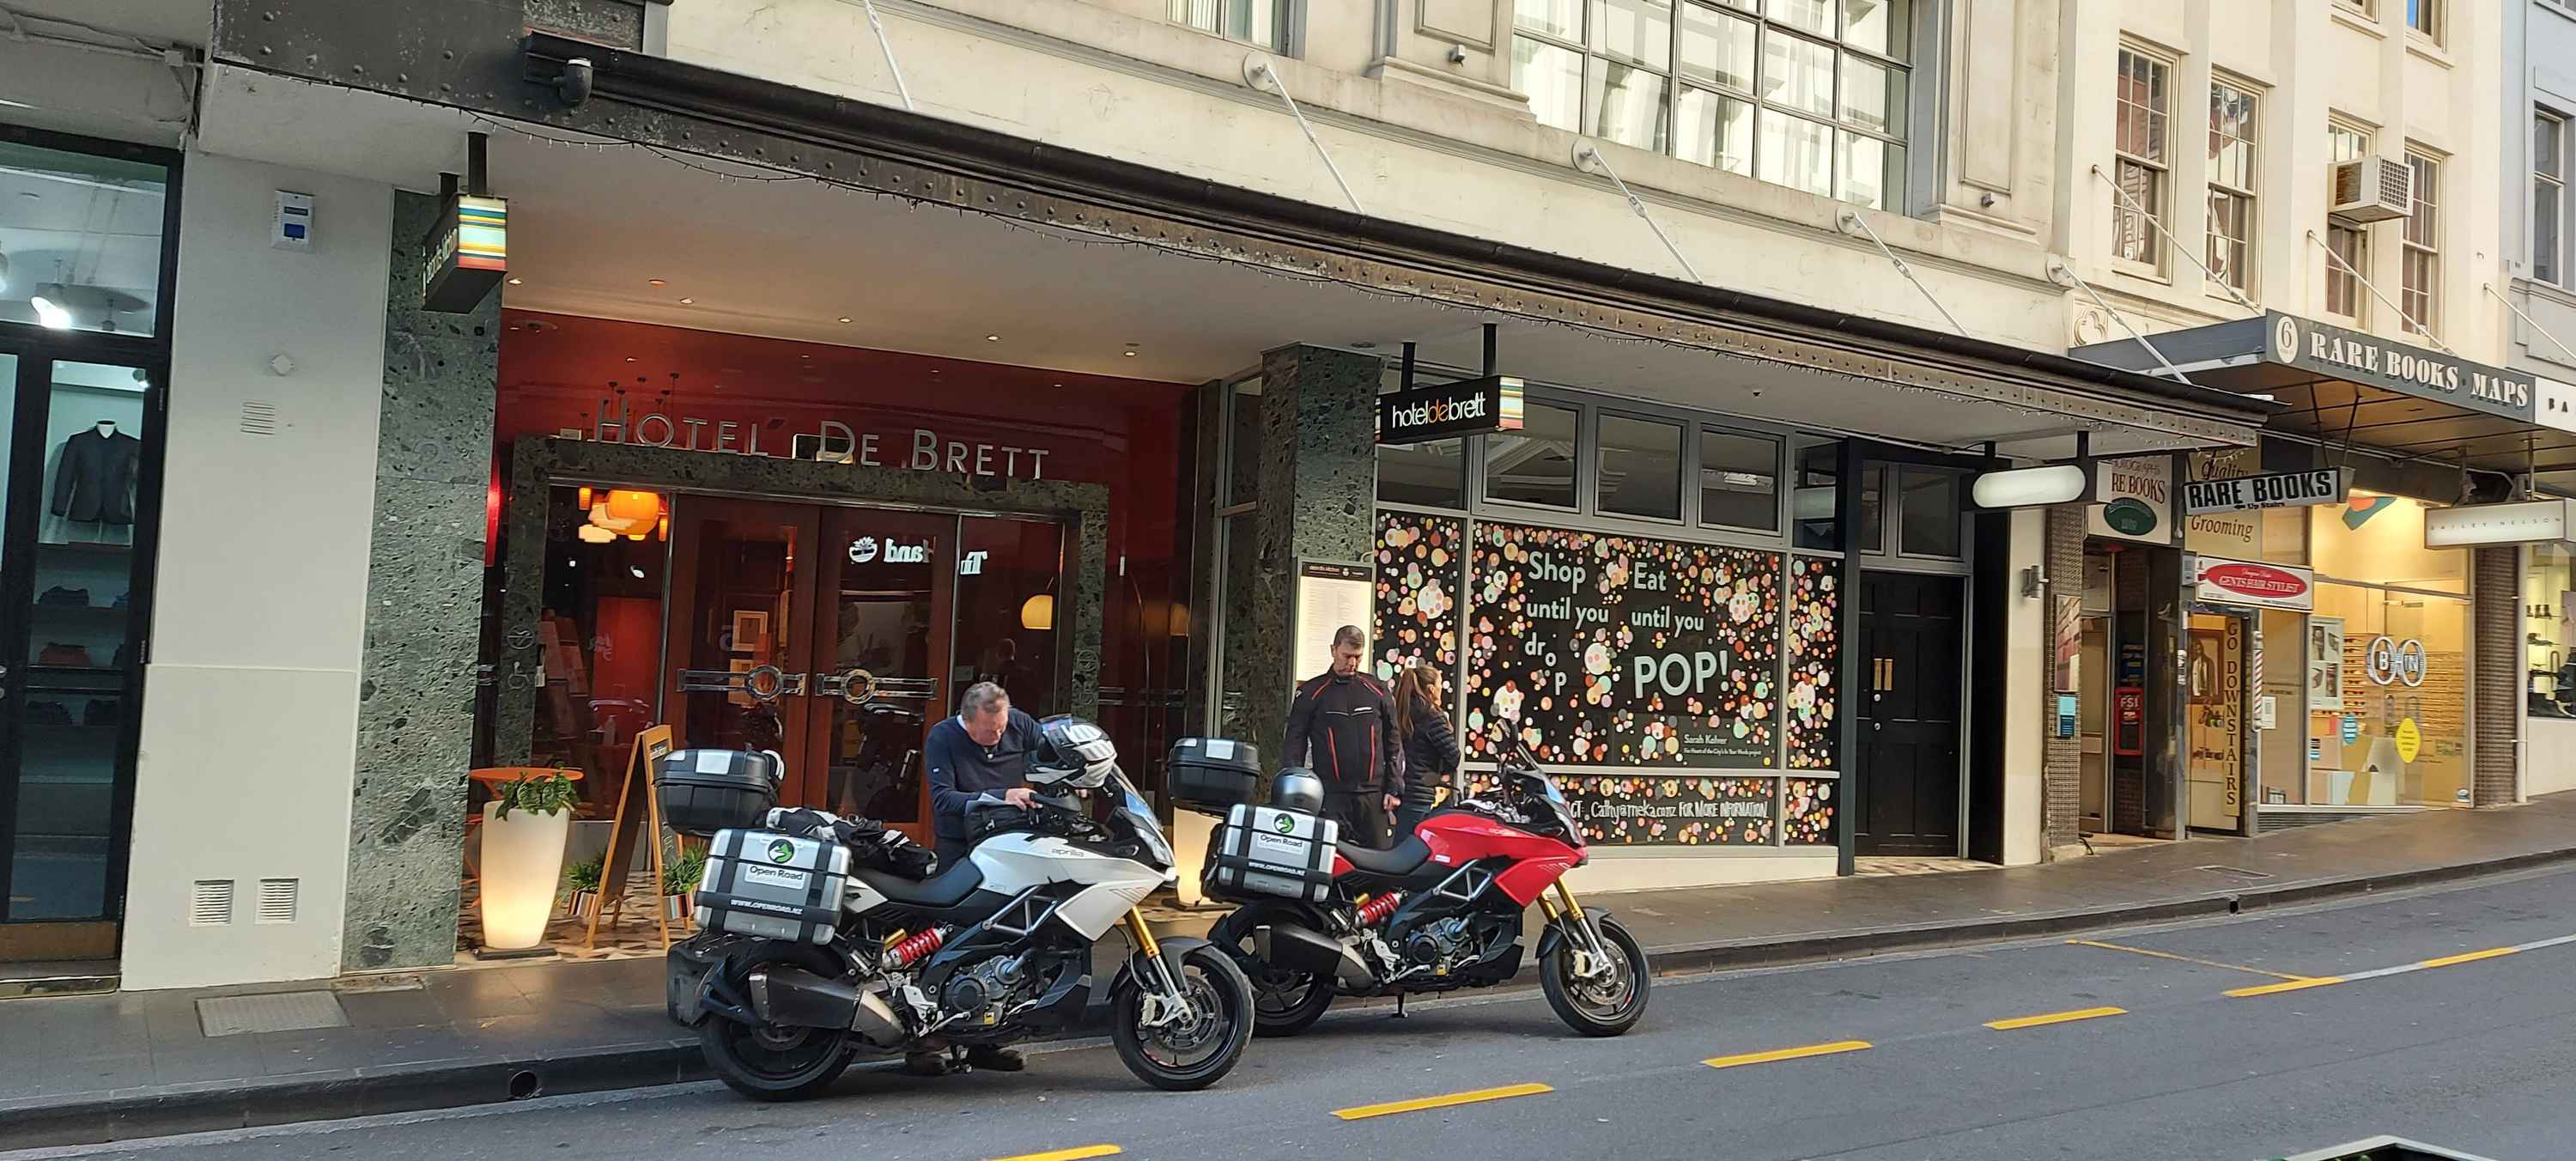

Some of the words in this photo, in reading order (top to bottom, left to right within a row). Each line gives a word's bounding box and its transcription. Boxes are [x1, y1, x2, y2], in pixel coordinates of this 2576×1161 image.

[2281, 320, 2292, 349] 6
[2309, 331, 2379, 374] RARE
[2385, 350, 2459, 392] BOOKS
[2470, 372, 2529, 408] MAPS
[2111, 472, 2125, 492] RE
[2129, 475, 2166, 504] BOOKS
[2190, 481, 2244, 509] RARE
[2252, 471, 2332, 503] BOOKS
[2190, 514, 2254, 543] Grooming
[1528, 550, 1587, 594] Shop
[1633, 561, 1668, 592] Eat
[1526, 596, 1571, 620] until
[1574, 605, 1609, 630] you
[1631, 605, 1671, 629] until
[1674, 615, 1704, 638] you
[2226, 622, 2239, 651] GO
[1633, 649, 1728, 699] POP!
[2225, 660, 2240, 805] DOWNSTAIRS
[1260, 834, 1282, 843] Open
[1282, 837, 1303, 848] Road
[750, 866, 777, 877] Open
[777, 869, 804, 881] Road
